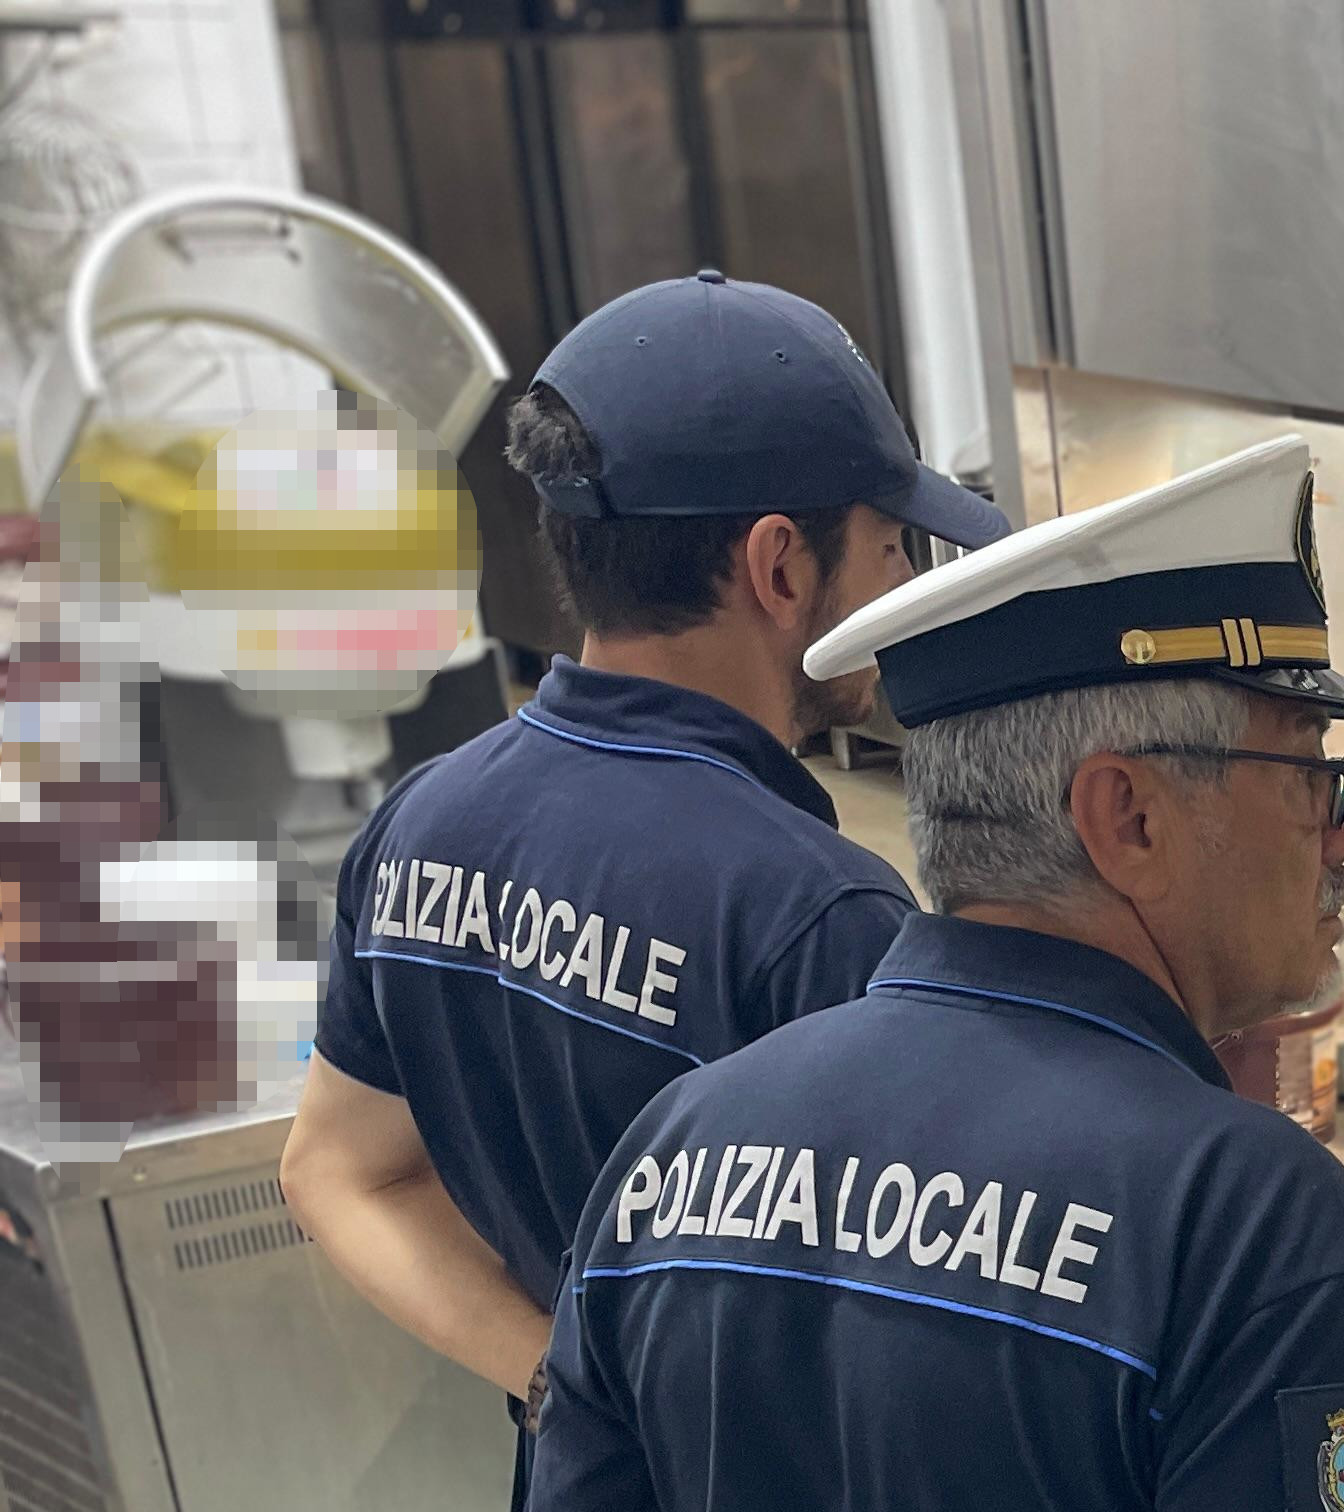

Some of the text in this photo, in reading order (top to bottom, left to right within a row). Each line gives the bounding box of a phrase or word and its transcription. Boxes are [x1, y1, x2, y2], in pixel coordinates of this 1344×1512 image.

[371, 858, 687, 1027] POLIZIA LOCALE
[616, 1144, 1114, 1304] POLIZIA LOCALE
